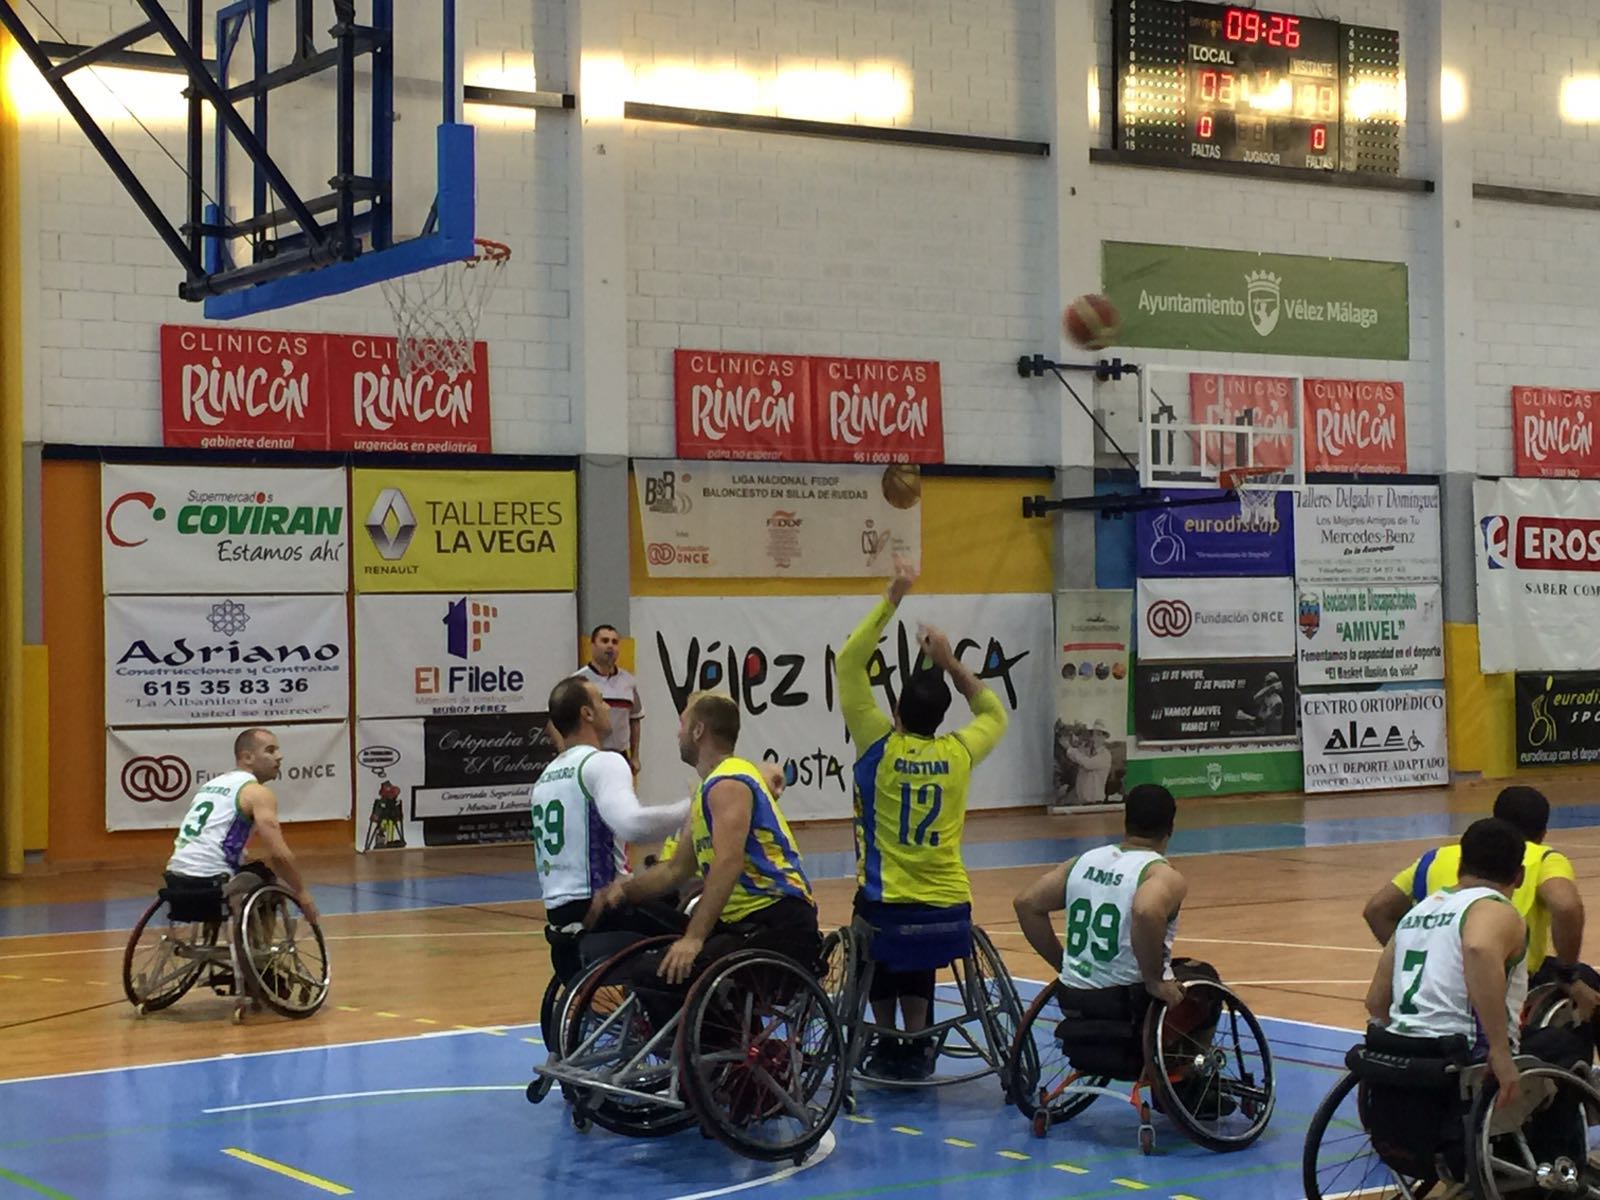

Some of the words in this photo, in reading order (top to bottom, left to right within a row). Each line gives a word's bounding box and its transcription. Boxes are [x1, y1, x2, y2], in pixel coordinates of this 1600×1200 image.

[1129, 13, 1136, 23] 5
[1225, 9, 1302, 49] 09:26
[1129, 38, 1136, 48] 7
[1129, 51, 1136, 61] 8
[1193, 47, 1235, 64] LOCAL
[1200, 116, 1212, 138] 0
[1124, 139, 1136, 150] 15
[1313, 128, 1326, 150] 0
[1192, 143, 1221, 160] FALTAS
[1243, 150, 1281, 165] JUGADOR
[1306, 155, 1334, 171] FALTAS
[1138, 289, 1246, 318] Ayuntamiento
[1285, 298, 1324, 321] Vélez
[1328, 302, 1379, 328] Málaga
[180, 331, 309, 356] CLINICAS
[690, 355, 796, 378] CLINICAS
[828, 362, 928, 384] CLINICAS
[1205, 378, 1289, 398] CINICAS
[1315, 382, 1396, 402] CLINICAS
[1523, 391, 1593, 409] CLINICAS
[200, 436, 254, 450] gabinete
[257, 436, 295, 450] dental
[353, 439, 410, 455] urgencias
[411, 442, 426, 453] en
[732, 475, 756, 487] LIGA
[757, 475, 808, 487] NACIONAL
[187, 489, 275, 506] Supermercados
[703, 486, 769, 499] BALONCESTO
[770, 487, 785, 499] EN
[786, 487, 815, 500] SILLA
[816, 488, 830, 500] DE
[832, 488, 869, 500] RUEDAS
[1335, 486, 1375, 513] Delgado
[177, 504, 344, 537] COVIRAN
[425, 501, 564, 527] TALLERES
[1315, 514, 1332, 526] Los
[1332, 514, 1366, 528] Mejores
[1366, 515, 1397, 528] Amigos
[1397, 514, 1409, 526] de
[1410, 514, 1421, 526] Tu
[435, 529, 473, 555] LA
[476, 529, 557, 555] VEGA
[1320, 528, 1416, 545] Mercedes-Benz
[217, 539, 304, 563] Estamos
[310, 539, 344, 563] ahí
[676, 553, 710, 565] ONCE
[363, 565, 420, 576] RENAULT
[1525, 581, 1568, 597] SABER
[1195, 610, 1251, 625] Fundación
[1252, 611, 1285, 623] ONCE
[116, 637, 341, 666] Adriano
[1300, 648, 1348, 662] Fomentamos
[1349, 647, 1357, 661] la
[1358, 647, 1394, 662] capacidad
[1395, 649, 1404, 660] en
[1404, 646, 1412, 660] el
[1413, 645, 1442, 660] deporte
[116, 665, 242, 678] Construcciones
[246, 667, 258, 678] y
[261, 663, 340, 675] Contratas
[1389, 665, 1399, 678] de
[143, 680, 191, 697] 615
[199, 679, 231, 696] 35
[239, 679, 271, 695] 83
[280, 677, 310, 694] 36
[414, 666, 441, 695] El
[448, 664, 525, 694] Filete
[262, 695, 294, 708] que
[1553, 688, 1600, 706] eurodi
[190, 707, 237, 719] usted
[240, 709, 259, 719] se
[1163, 706, 1192, 717] VAMOS
[1192, 705, 1222, 717] AMIVEL
[1303, 699, 1358, 716] CENTRO
[1181, 721, 1208, 732] VAMOS
[438, 728, 523, 756] Ortopedia
[287, 763, 337, 780] ONCE
[1306, 763, 1327, 777] CON
[1342, 760, 1389, 774] DEPORTE
[1391, 757, 1445, 772] ADAPTADO
[183, 800, 214, 837] 3
[899, 780, 945, 847] 12
[1066, 897, 1122, 963] 89
[1398, 949, 1428, 1015] 7
